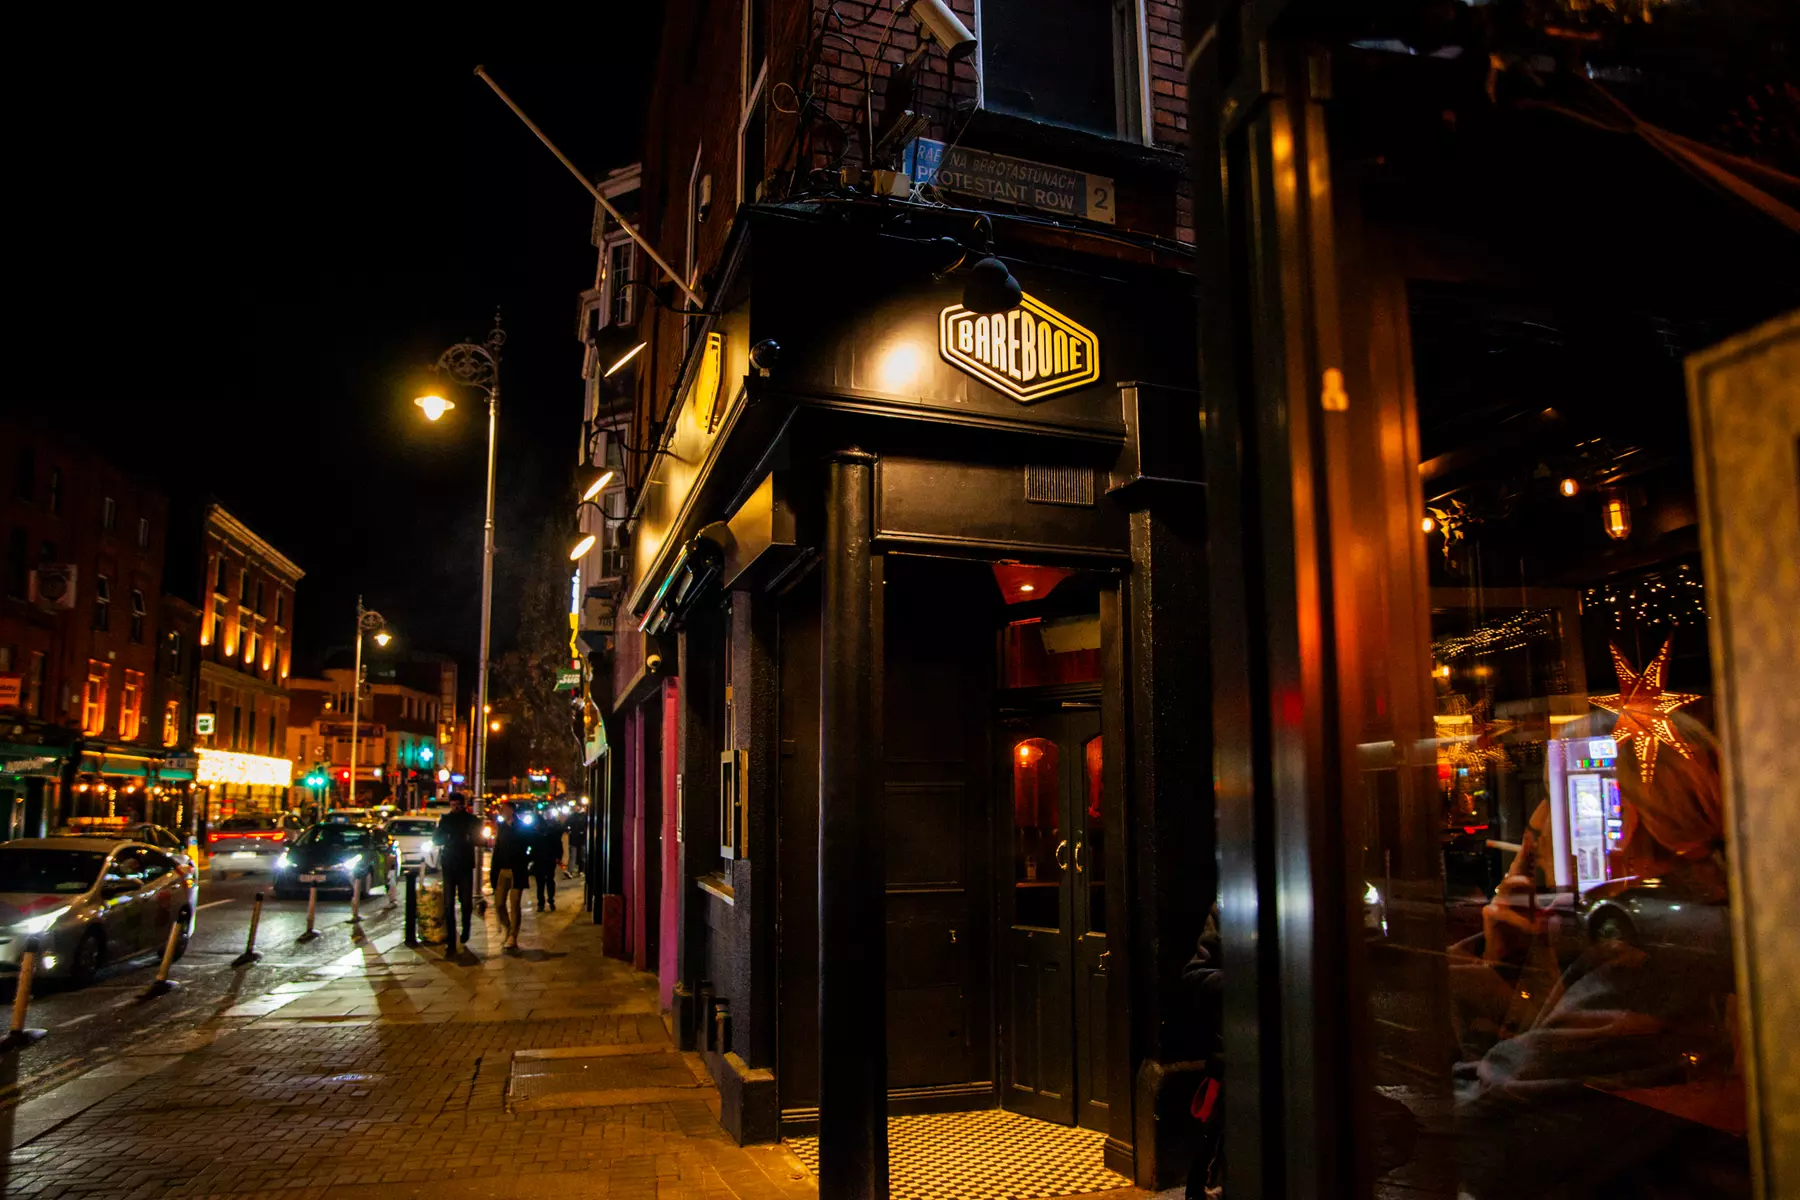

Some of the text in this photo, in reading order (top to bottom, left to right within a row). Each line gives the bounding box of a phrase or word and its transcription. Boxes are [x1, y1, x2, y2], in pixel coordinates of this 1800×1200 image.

[918, 144, 943, 163] RAE
[950, 152, 967, 169] NA
[918, 165, 1074, 210] PROTESTANT ROW
[1094, 188, 1108, 210] 2
[958, 310, 1083, 382] BAREBONE
